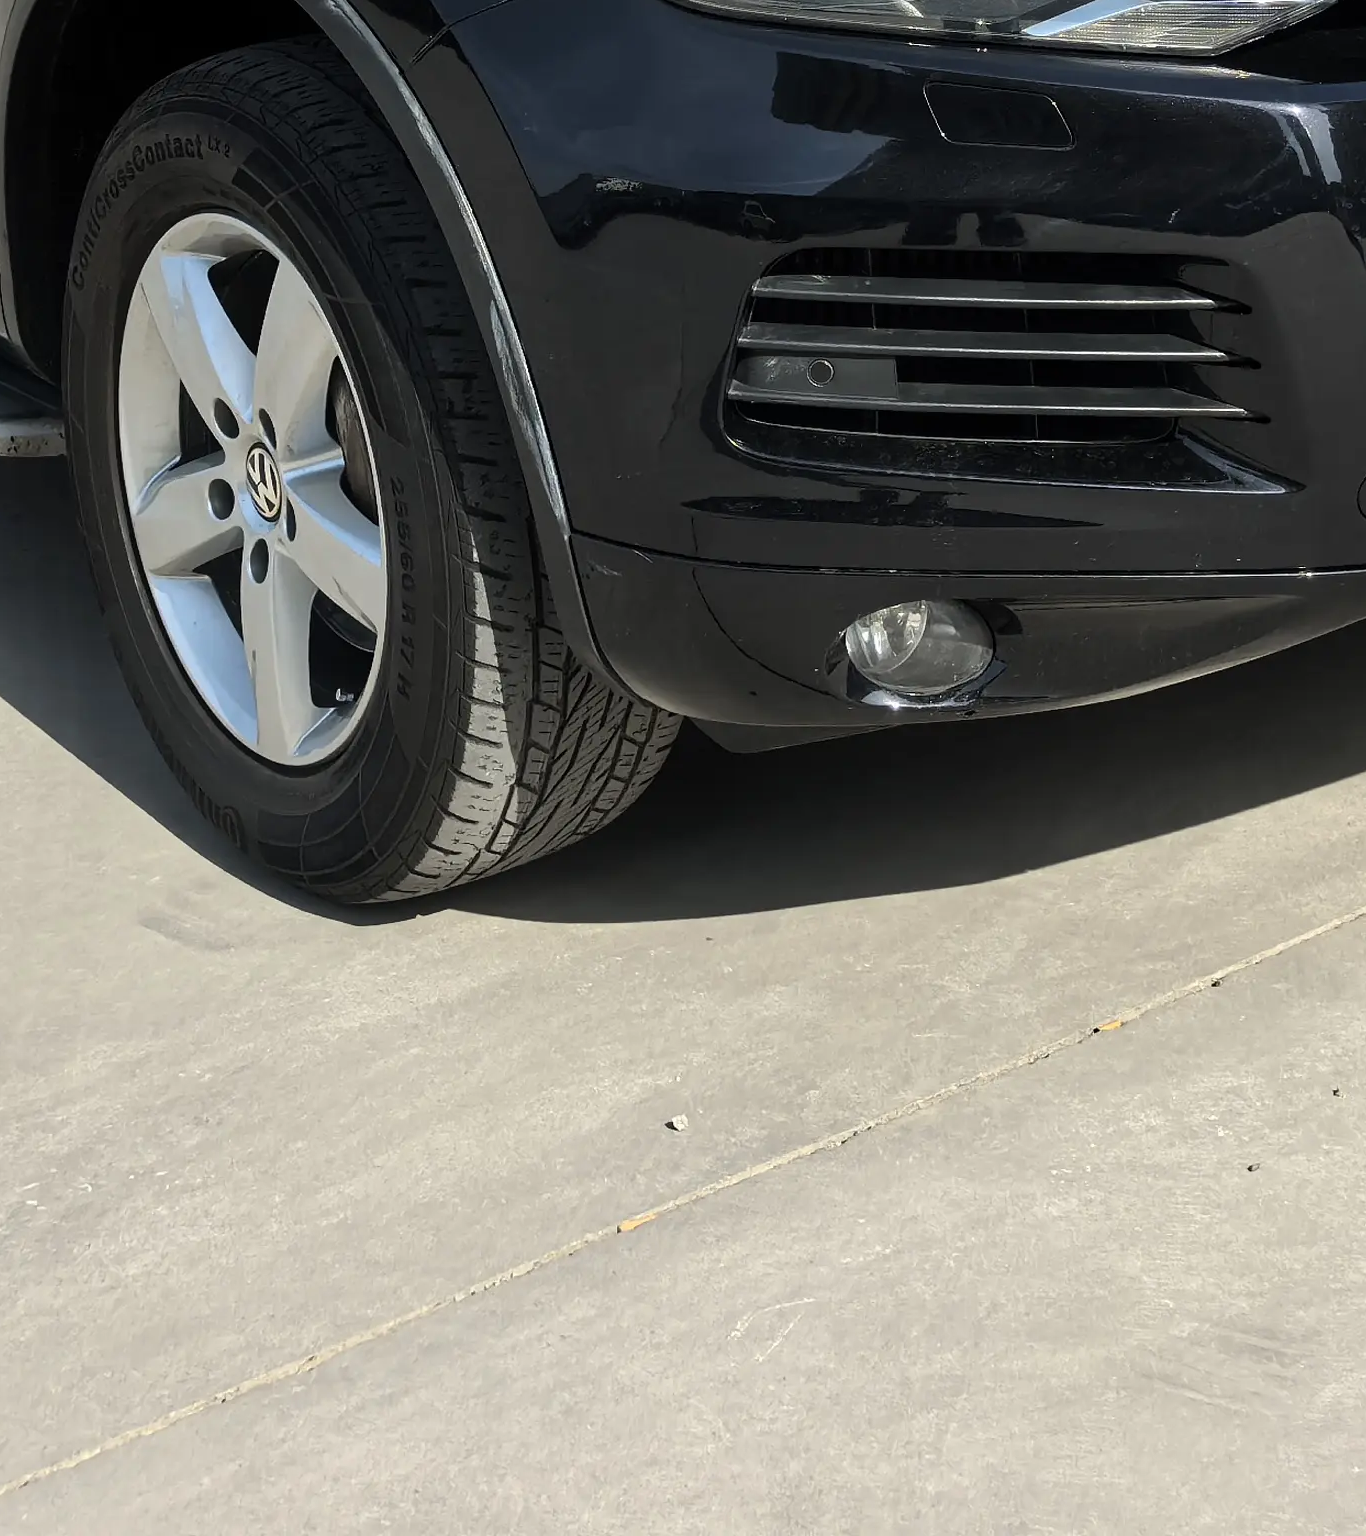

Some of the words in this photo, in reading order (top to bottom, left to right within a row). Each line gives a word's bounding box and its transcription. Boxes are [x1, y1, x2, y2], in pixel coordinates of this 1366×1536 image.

[71, 132, 204, 292] ContiCrossContact
[389, 474, 417, 593] 255/60
[399, 635, 416, 670] 17
